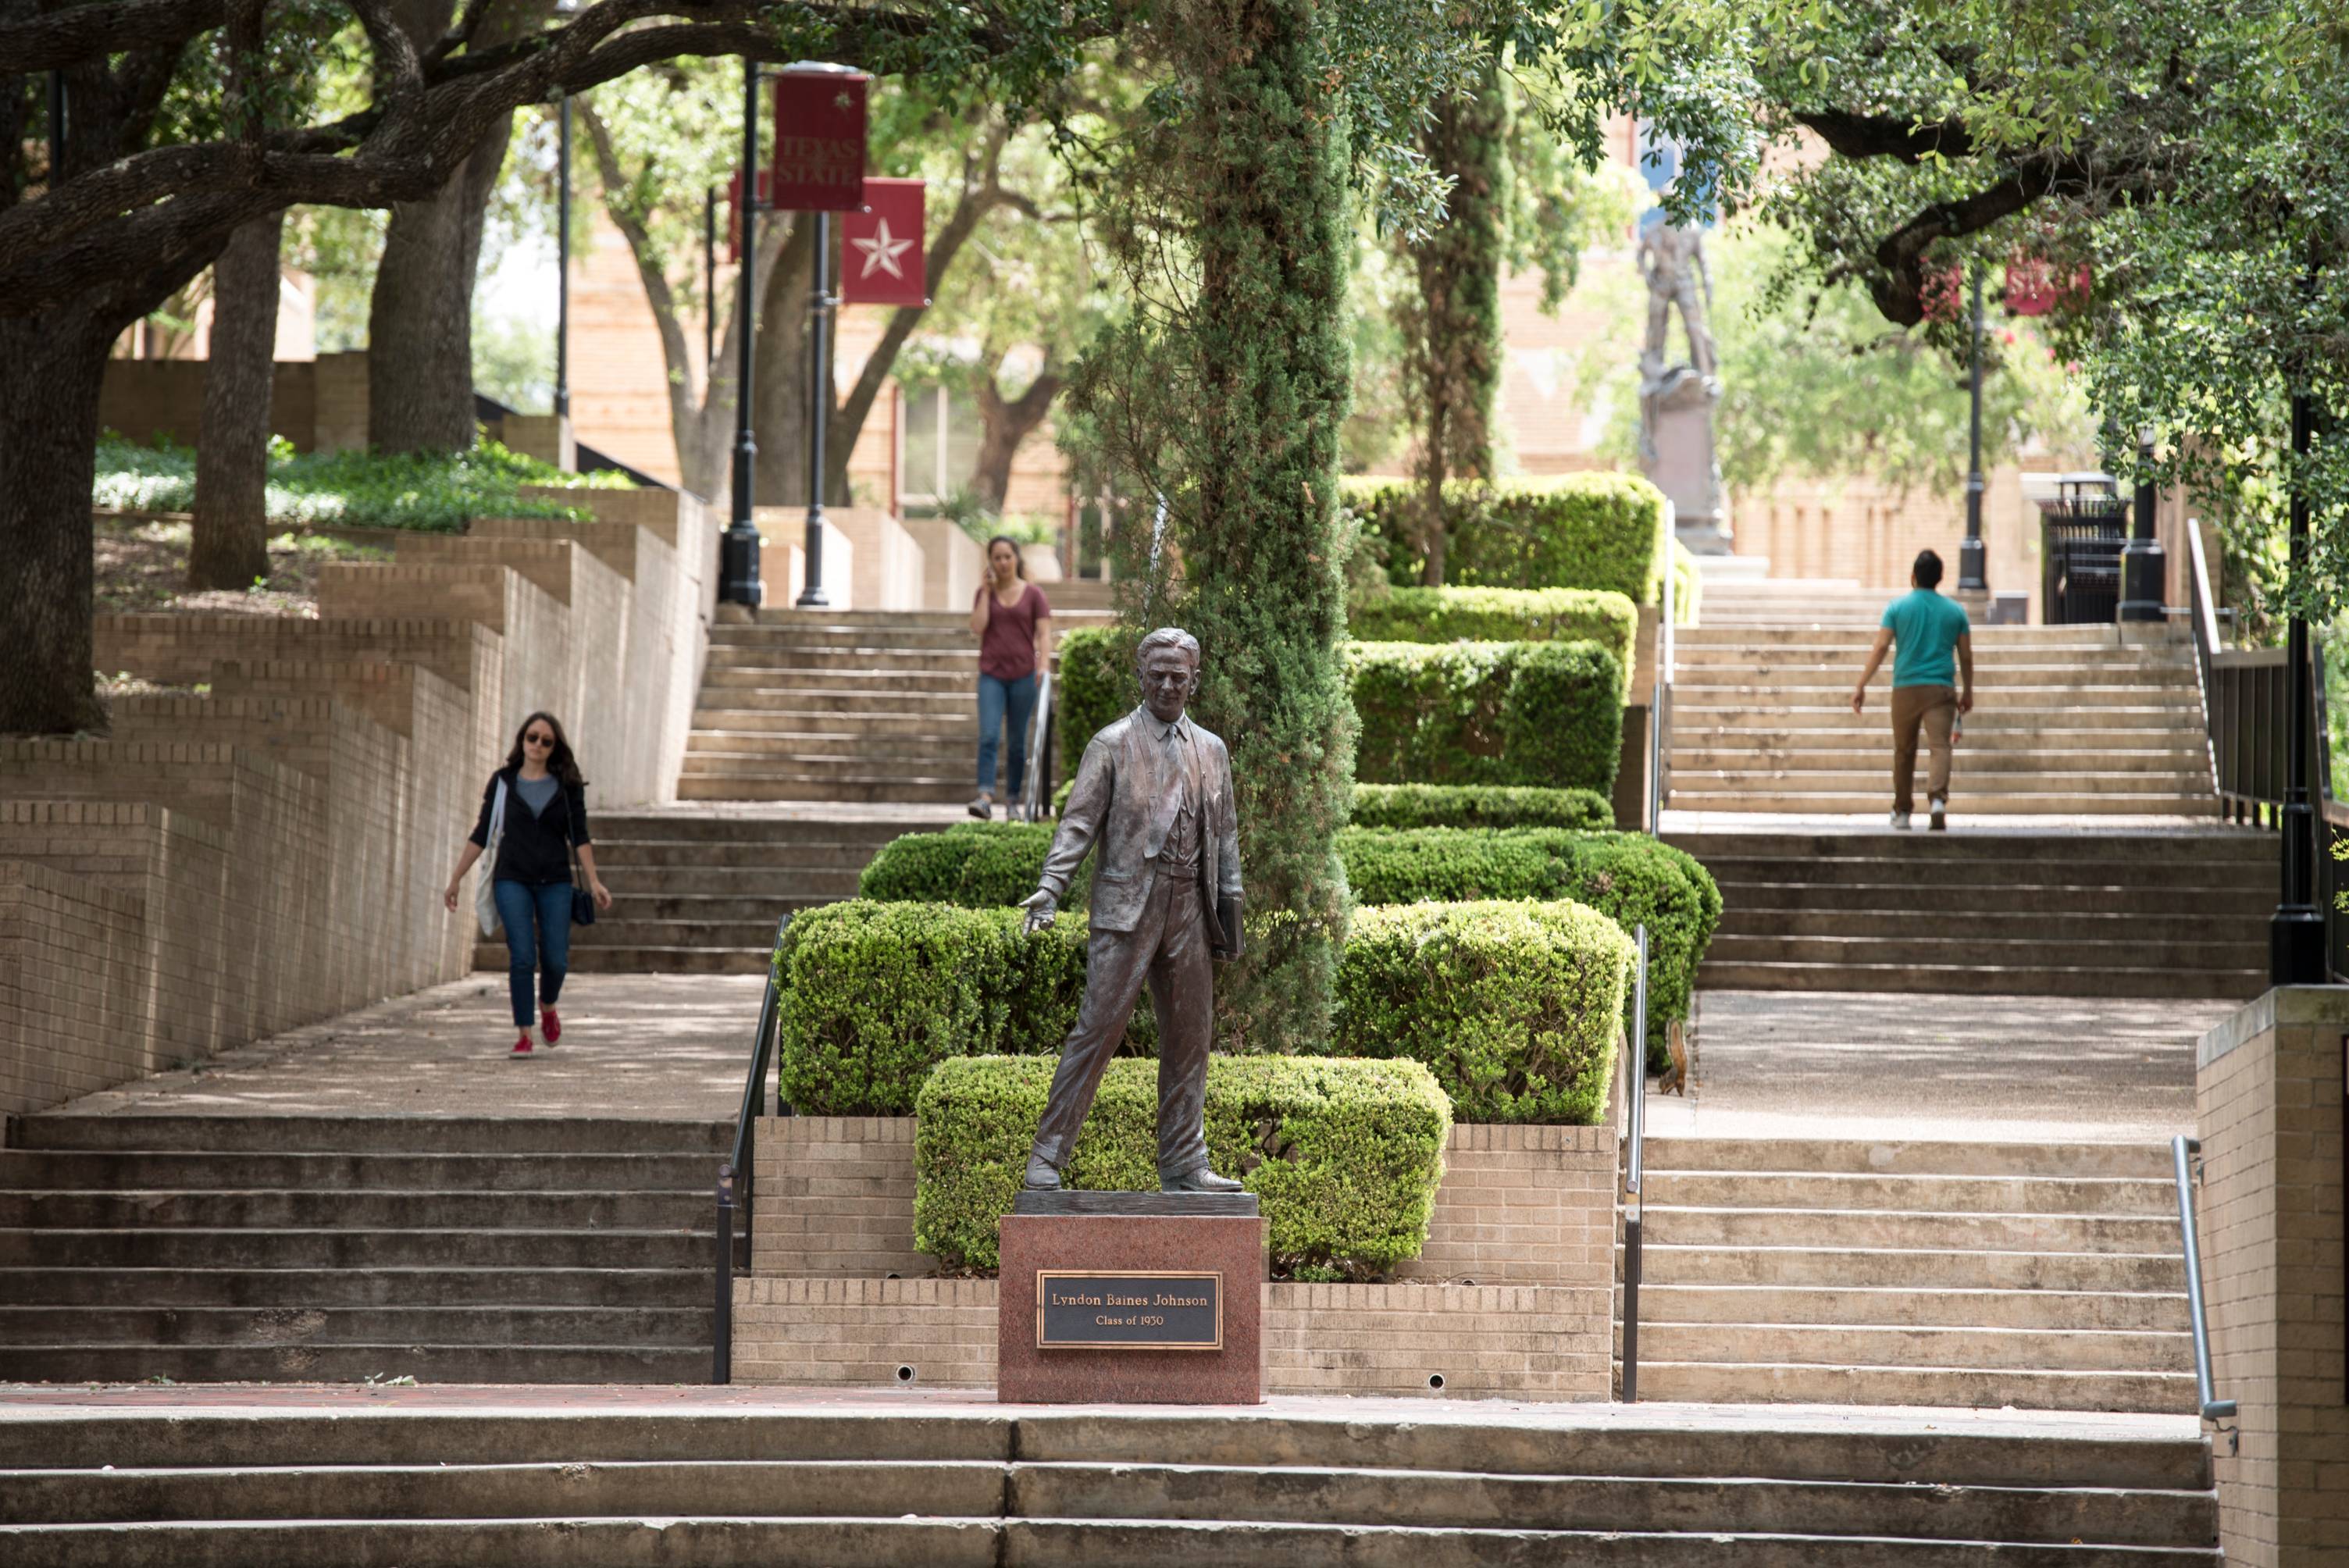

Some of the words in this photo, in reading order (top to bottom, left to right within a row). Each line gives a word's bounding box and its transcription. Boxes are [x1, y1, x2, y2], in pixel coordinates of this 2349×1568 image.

[781, 136, 857, 158] TEXAS
[777, 161, 855, 187] STATE
[1052, 1293, 1101, 1306] Lyndon
[1107, 1294, 1148, 1306] Baines
[1153, 1294, 1208, 1306] Johnson
[1096, 1315, 1122, 1326] Class
[1126, 1315, 1136, 1326] of
[1141, 1316, 1164, 1327] 1930
